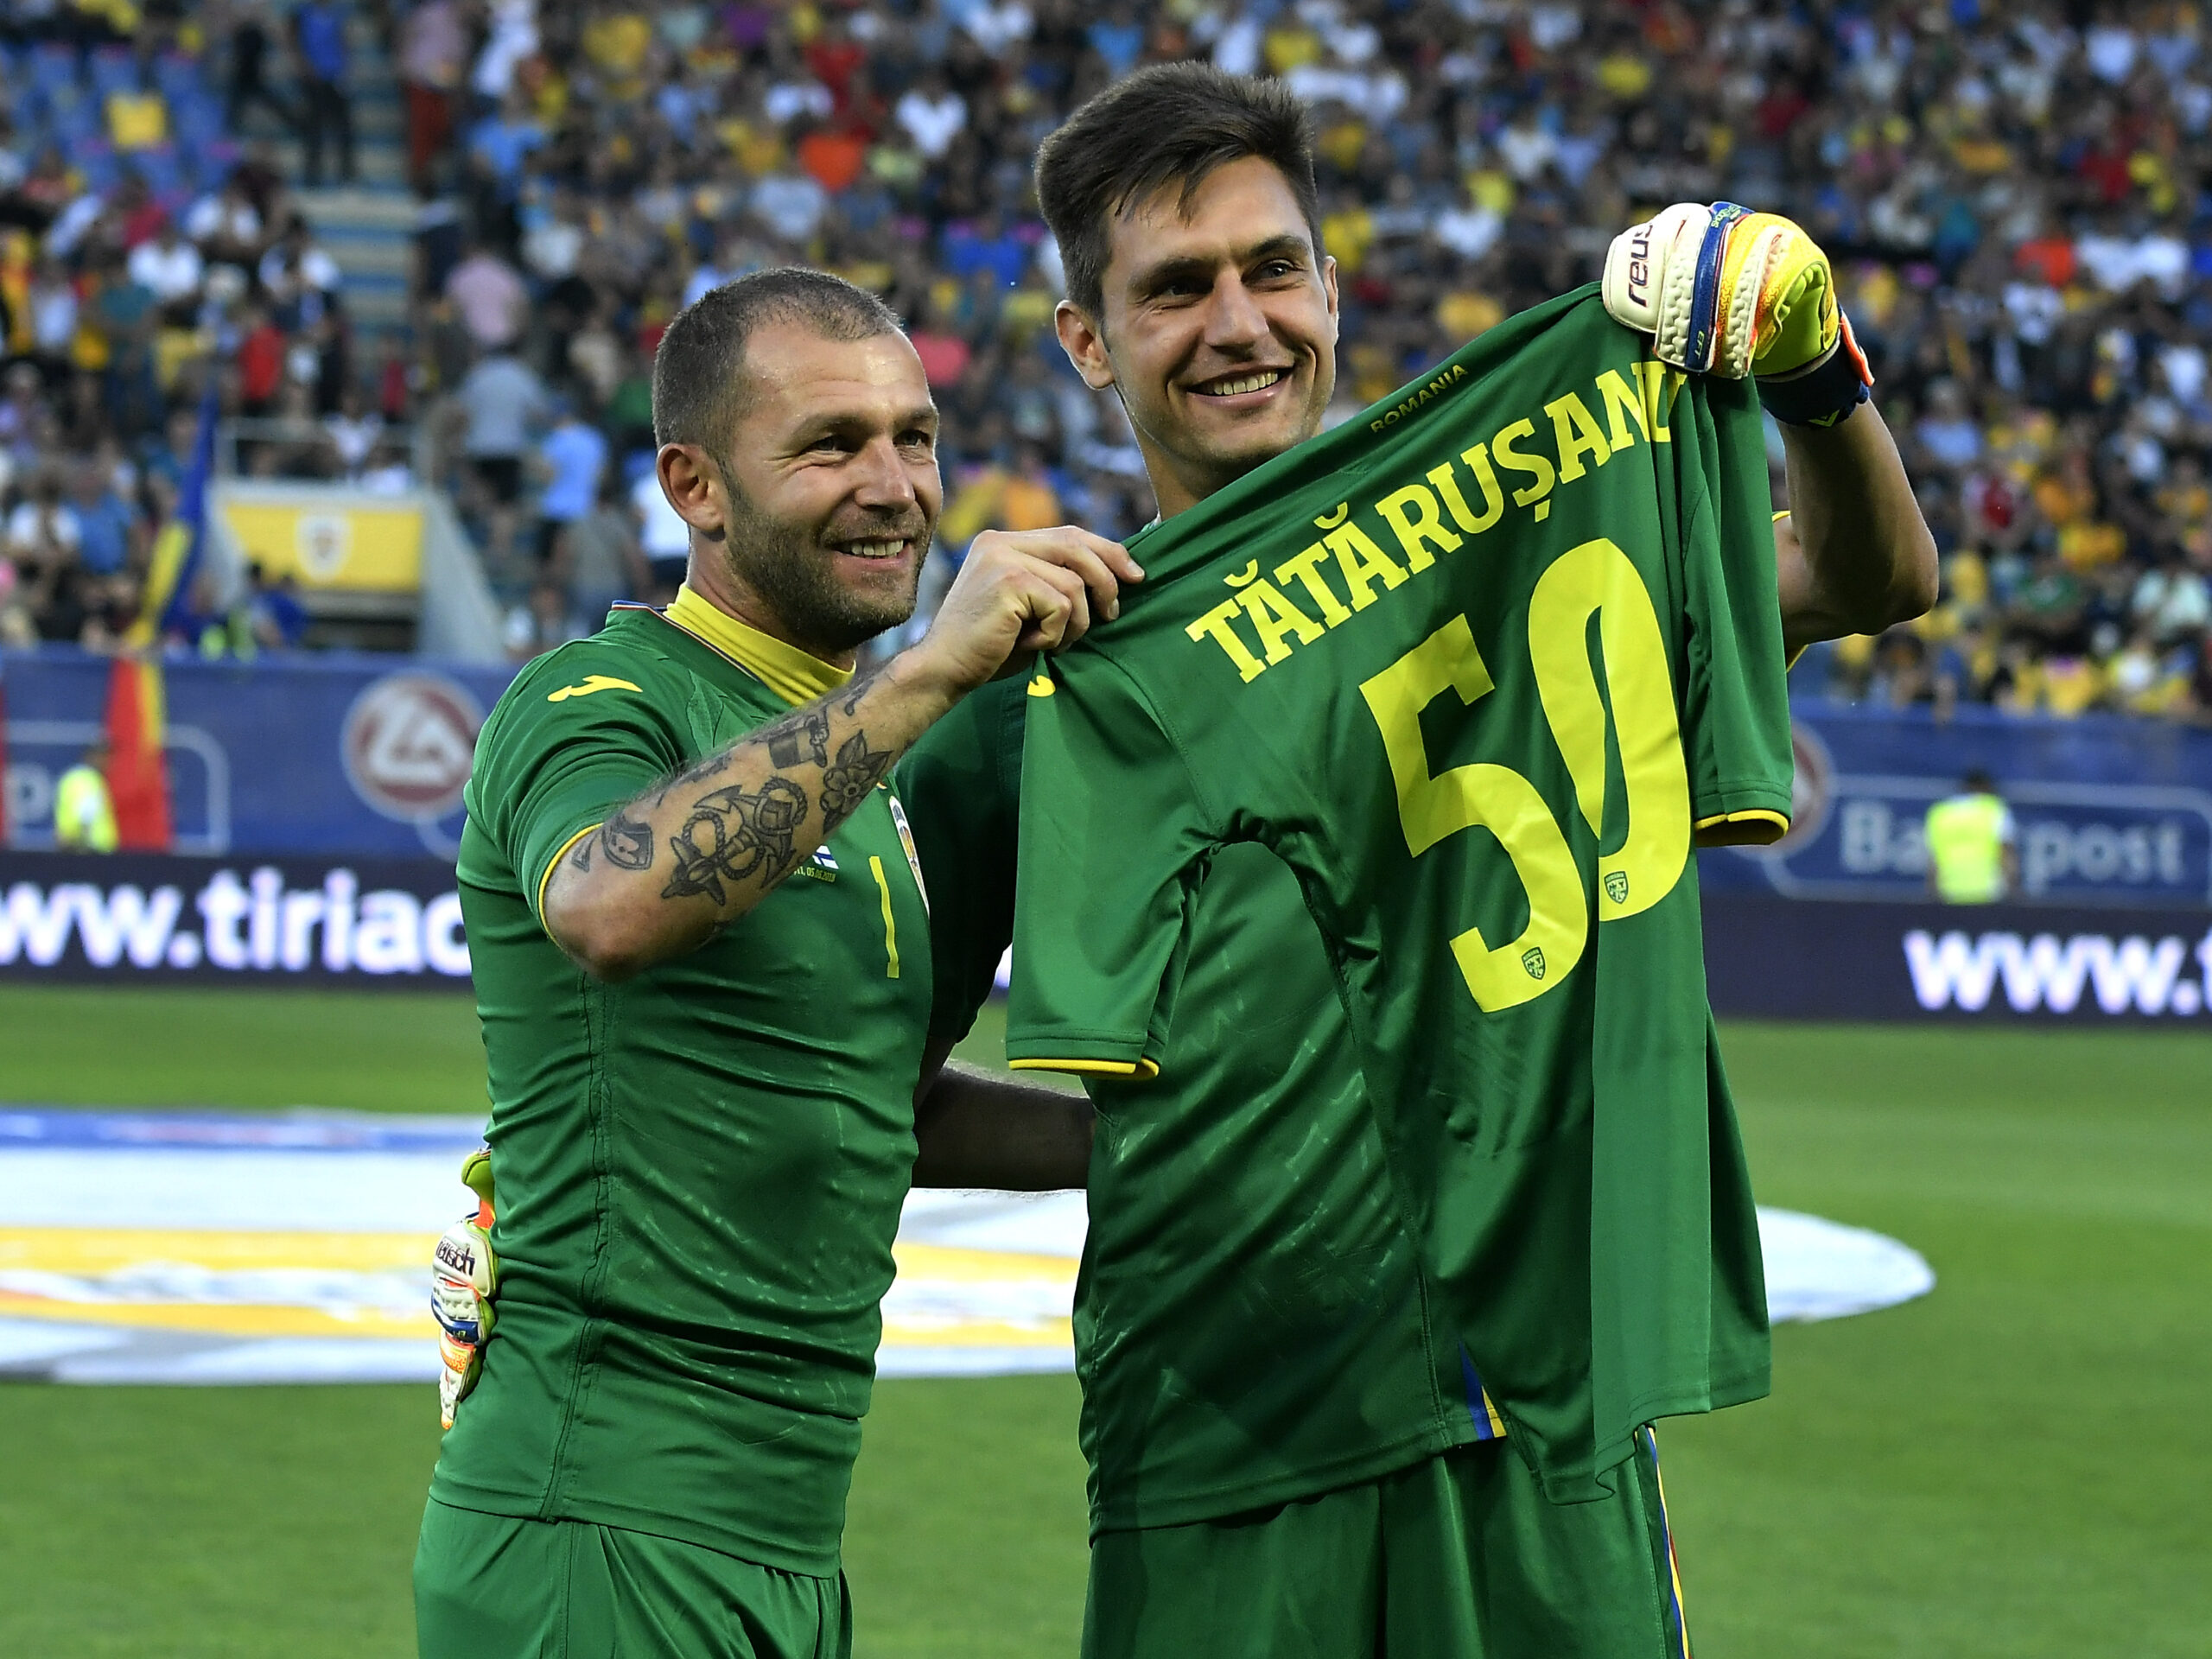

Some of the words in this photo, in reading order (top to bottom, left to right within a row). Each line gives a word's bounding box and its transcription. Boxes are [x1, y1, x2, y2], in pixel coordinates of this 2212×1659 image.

[1370, 365, 1468, 432] ROMANIA
[1359, 537, 1691, 1013] 50
[1840, 798, 2186, 900] Bapost
[868, 855, 899, 978] 1
